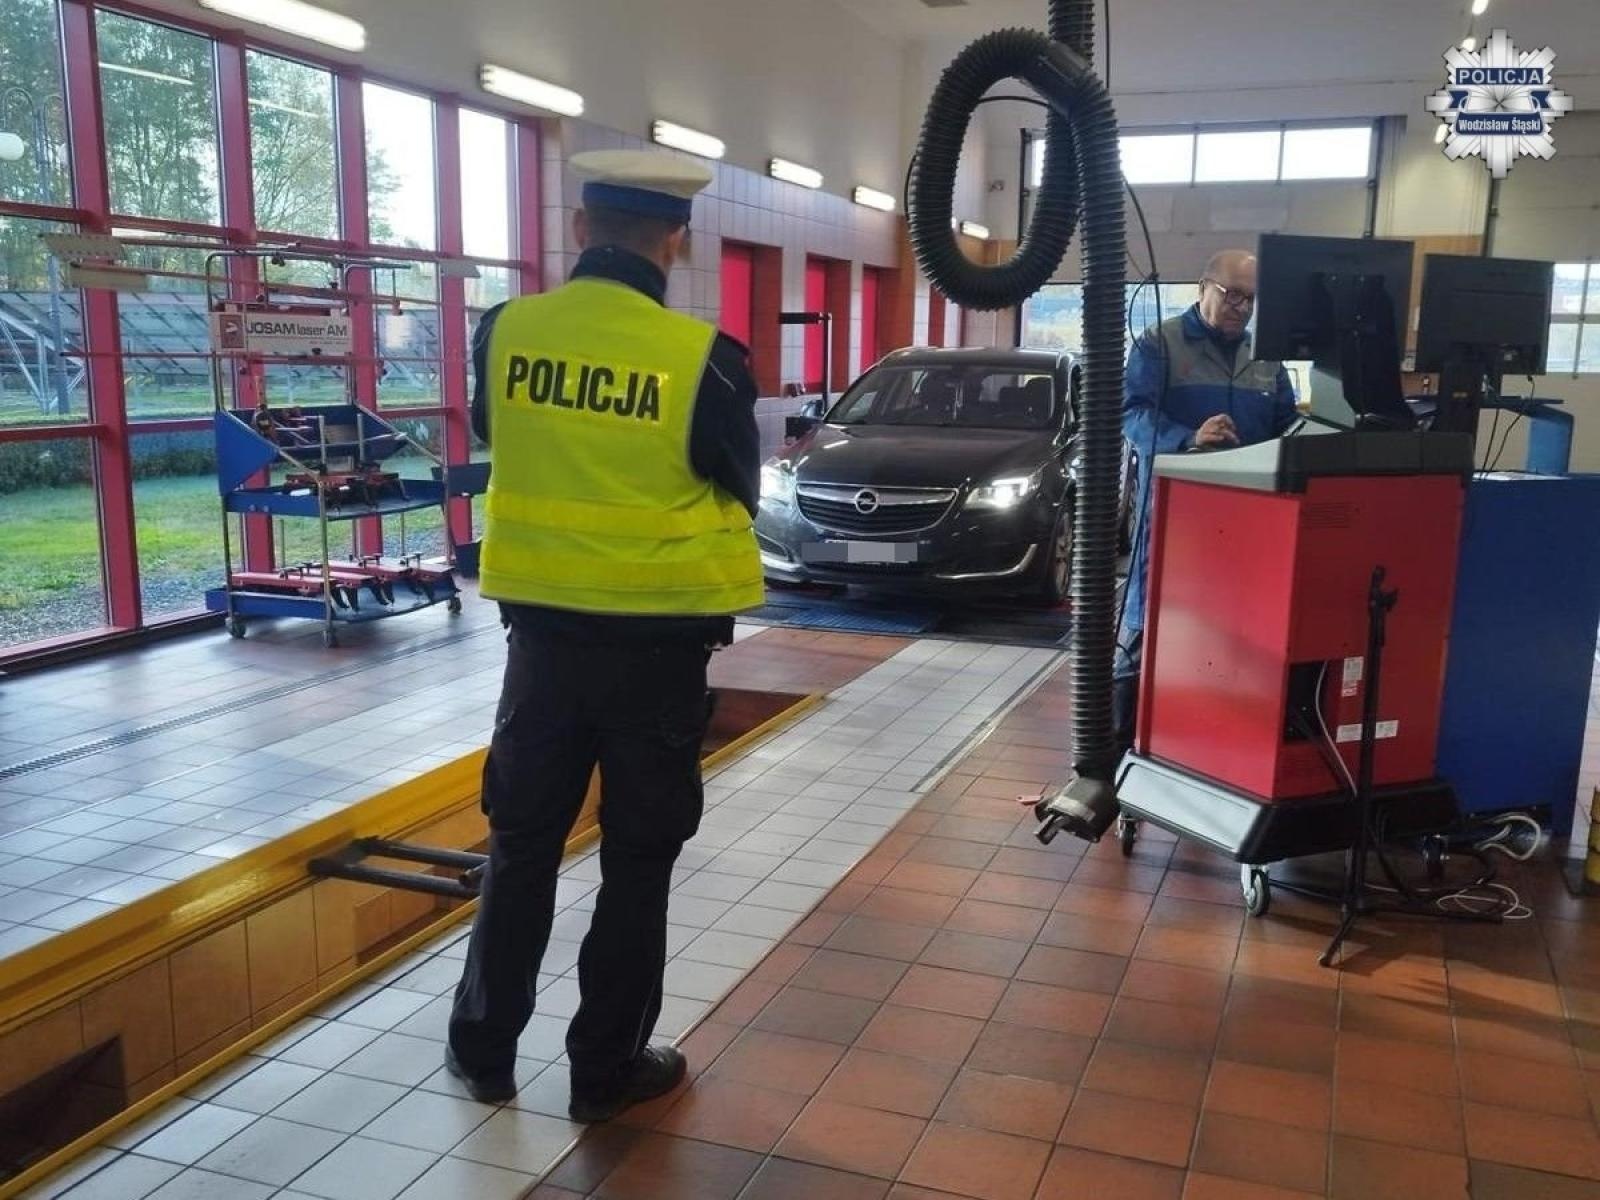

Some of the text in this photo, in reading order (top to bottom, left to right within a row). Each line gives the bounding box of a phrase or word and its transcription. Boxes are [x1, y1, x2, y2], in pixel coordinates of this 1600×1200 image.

[246, 321, 347, 337] JOSAM laser AM
[506, 355, 660, 421] POLICJA
